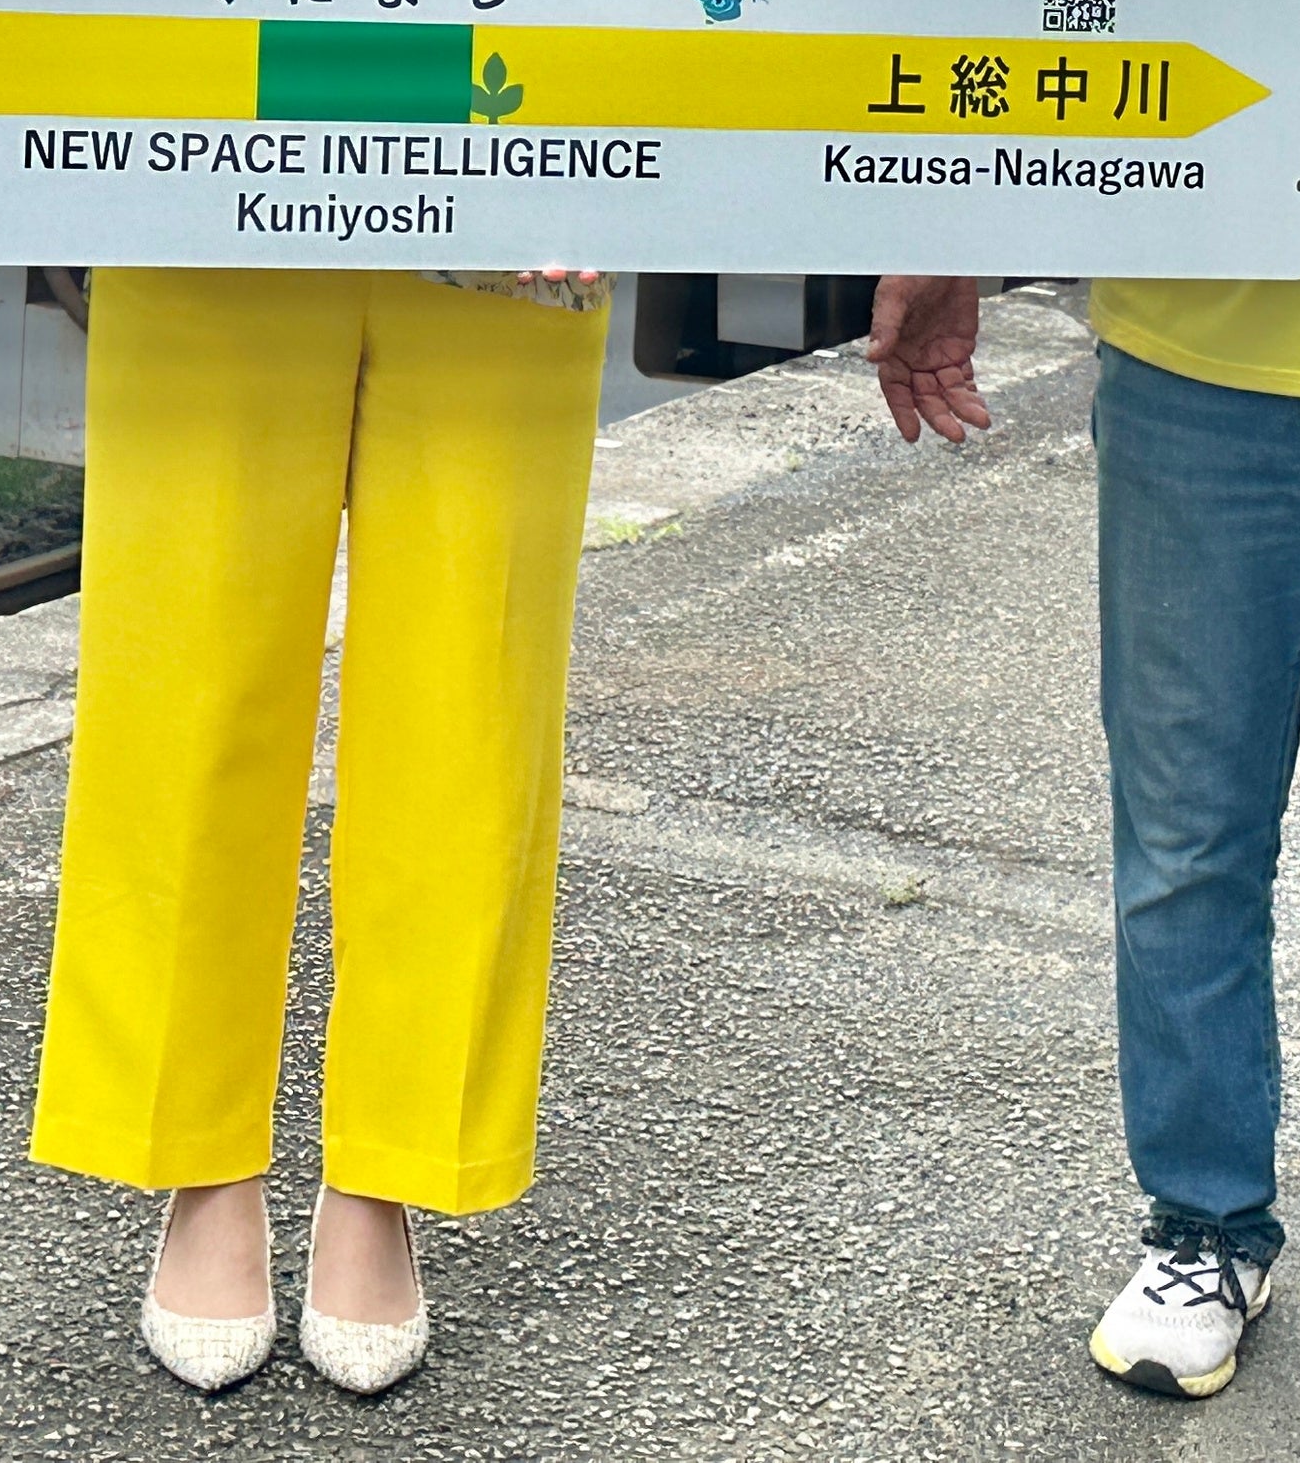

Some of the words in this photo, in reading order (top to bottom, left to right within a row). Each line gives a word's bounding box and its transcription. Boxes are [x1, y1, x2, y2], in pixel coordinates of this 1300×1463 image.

[867, 53, 1170, 122] 上総中川
[25, 130, 132, 170] NEW
[148, 132, 305, 173] SPACE
[323, 135, 661, 178] INTELLIGENCE
[824, 144, 1205, 196] Kazusa-Nakagawa
[236, 192, 455, 242] Kuniyoshi
